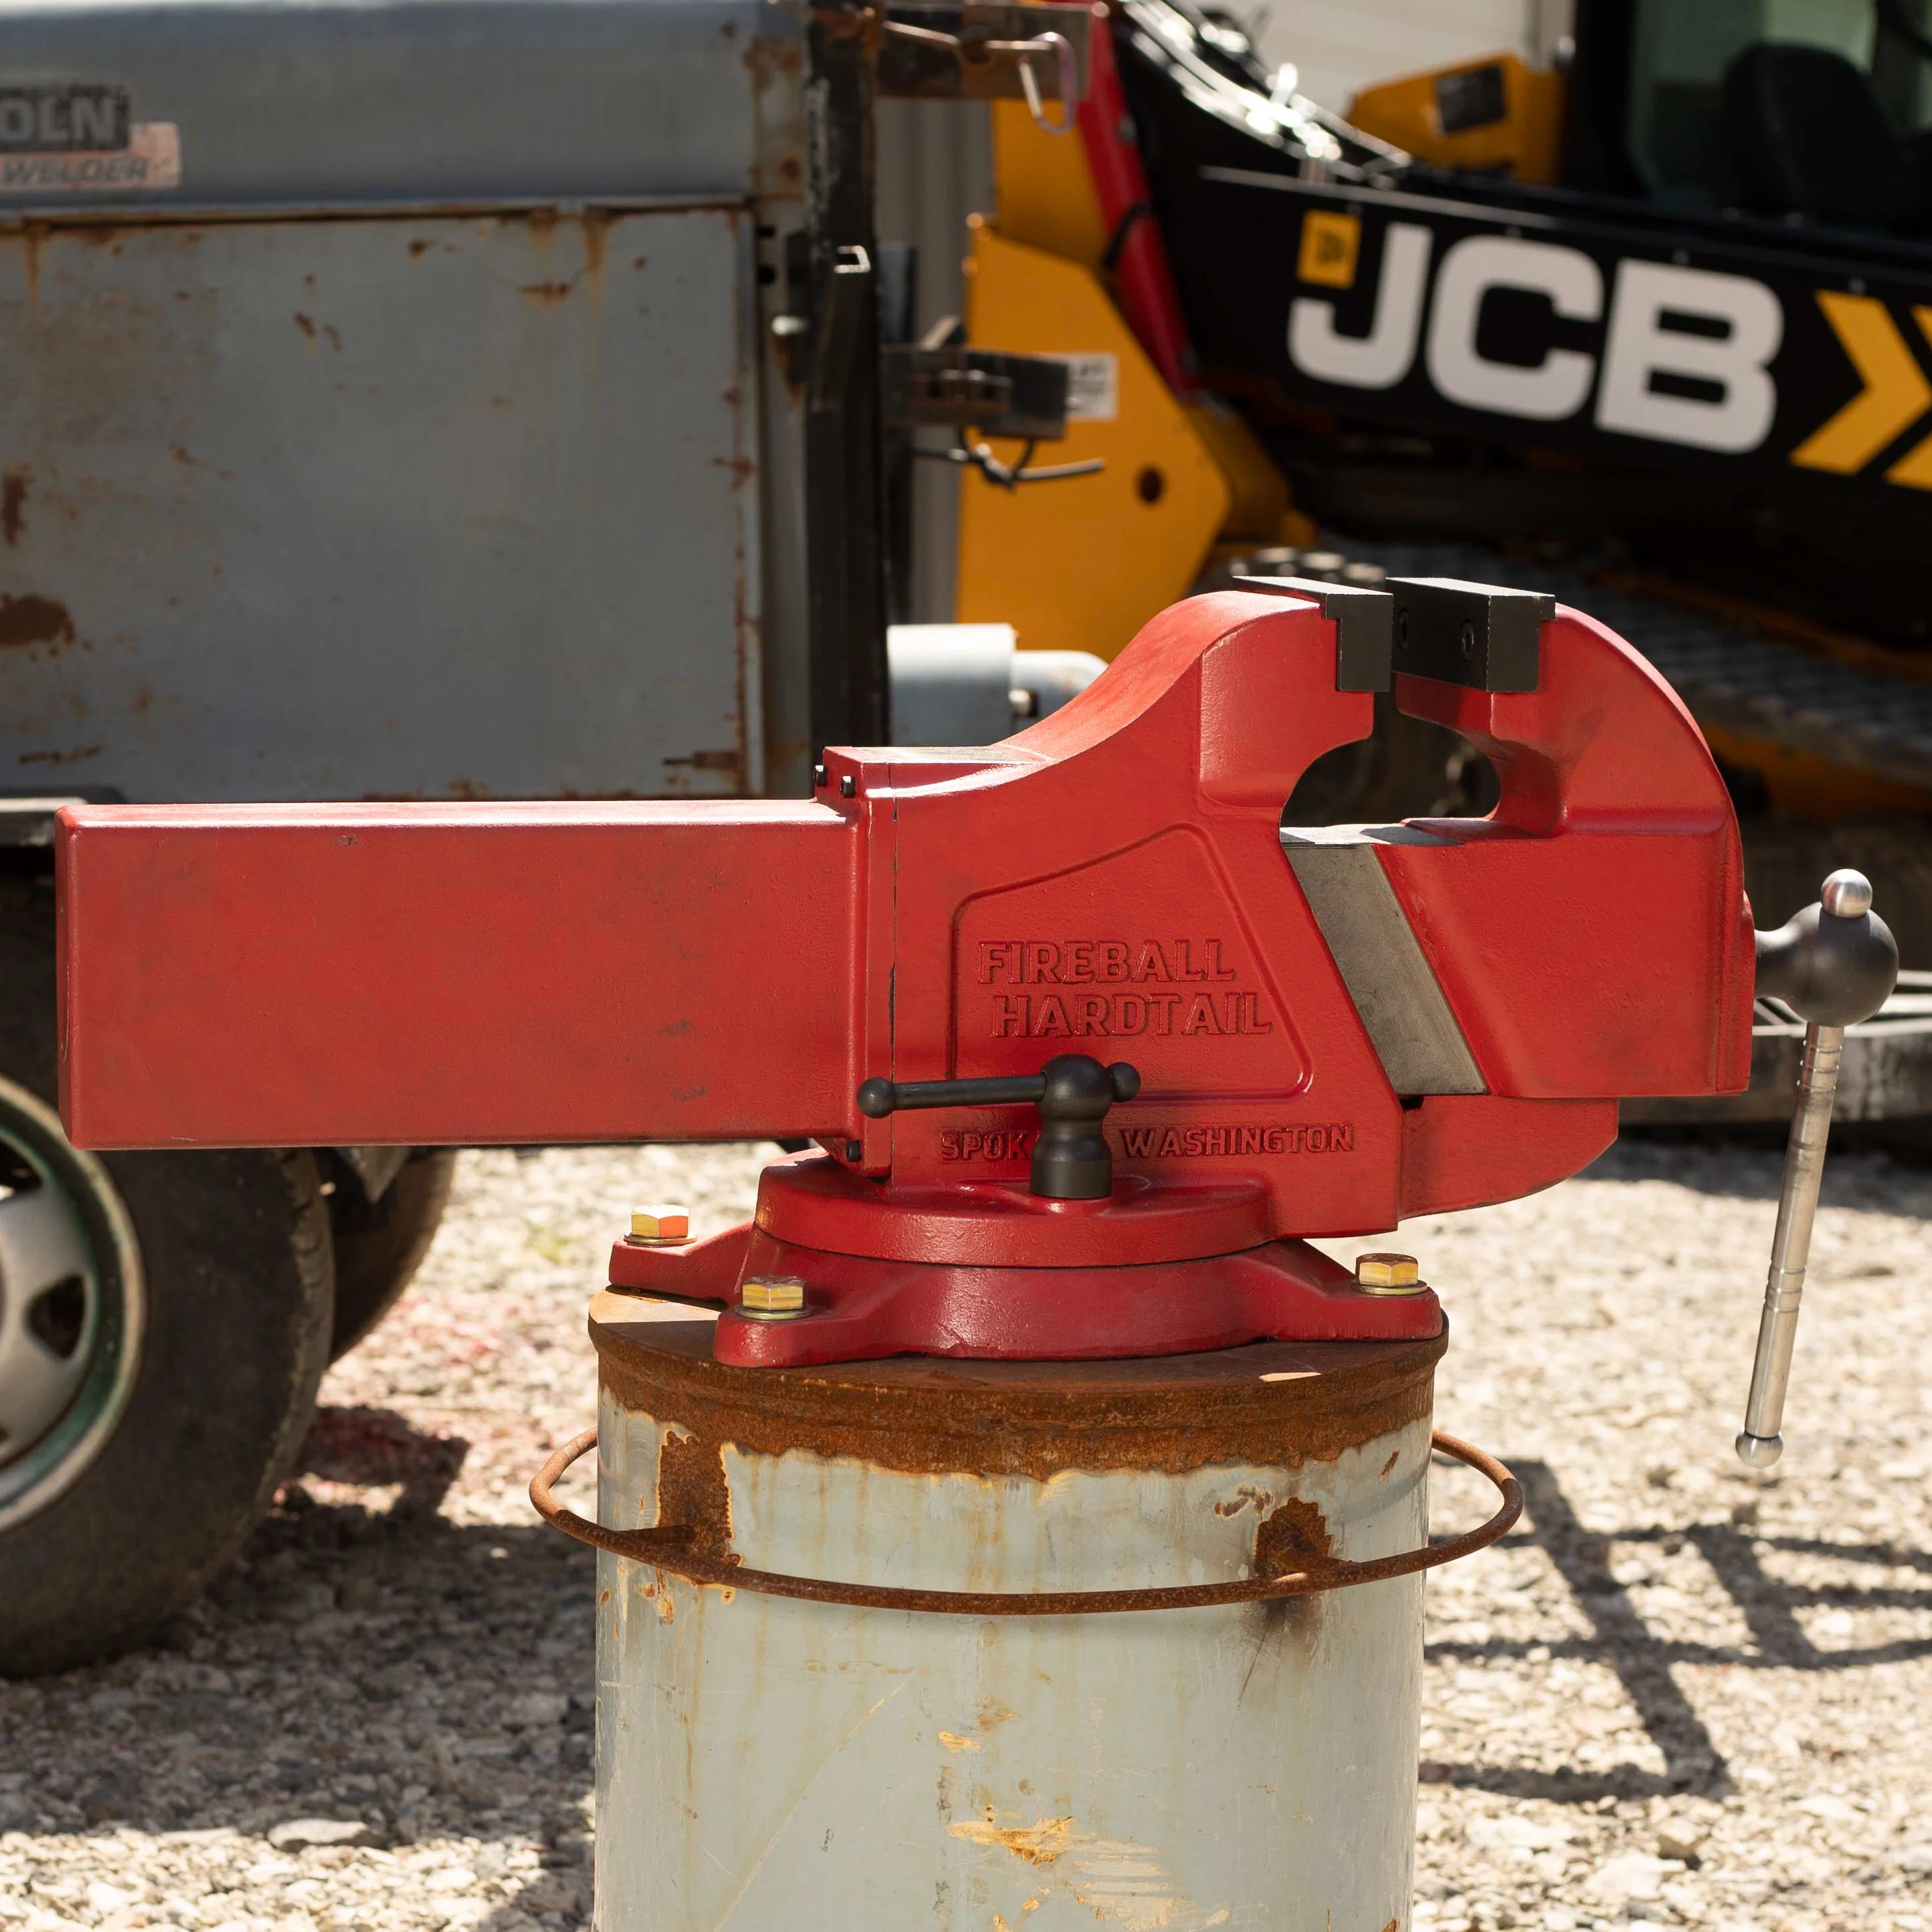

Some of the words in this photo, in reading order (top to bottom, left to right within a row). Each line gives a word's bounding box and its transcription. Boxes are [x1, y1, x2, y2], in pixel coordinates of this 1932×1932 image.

[3, 157, 150, 185] WELDER
[1287, 221, 1785, 454] JCB
[977, 938, 1236, 984] FIREBALL
[989, 991, 1273, 1038] HARDTAIL
[941, 1129, 1041, 1161] SPOK
[1120, 1123, 1354, 1158] WASHINGTON
